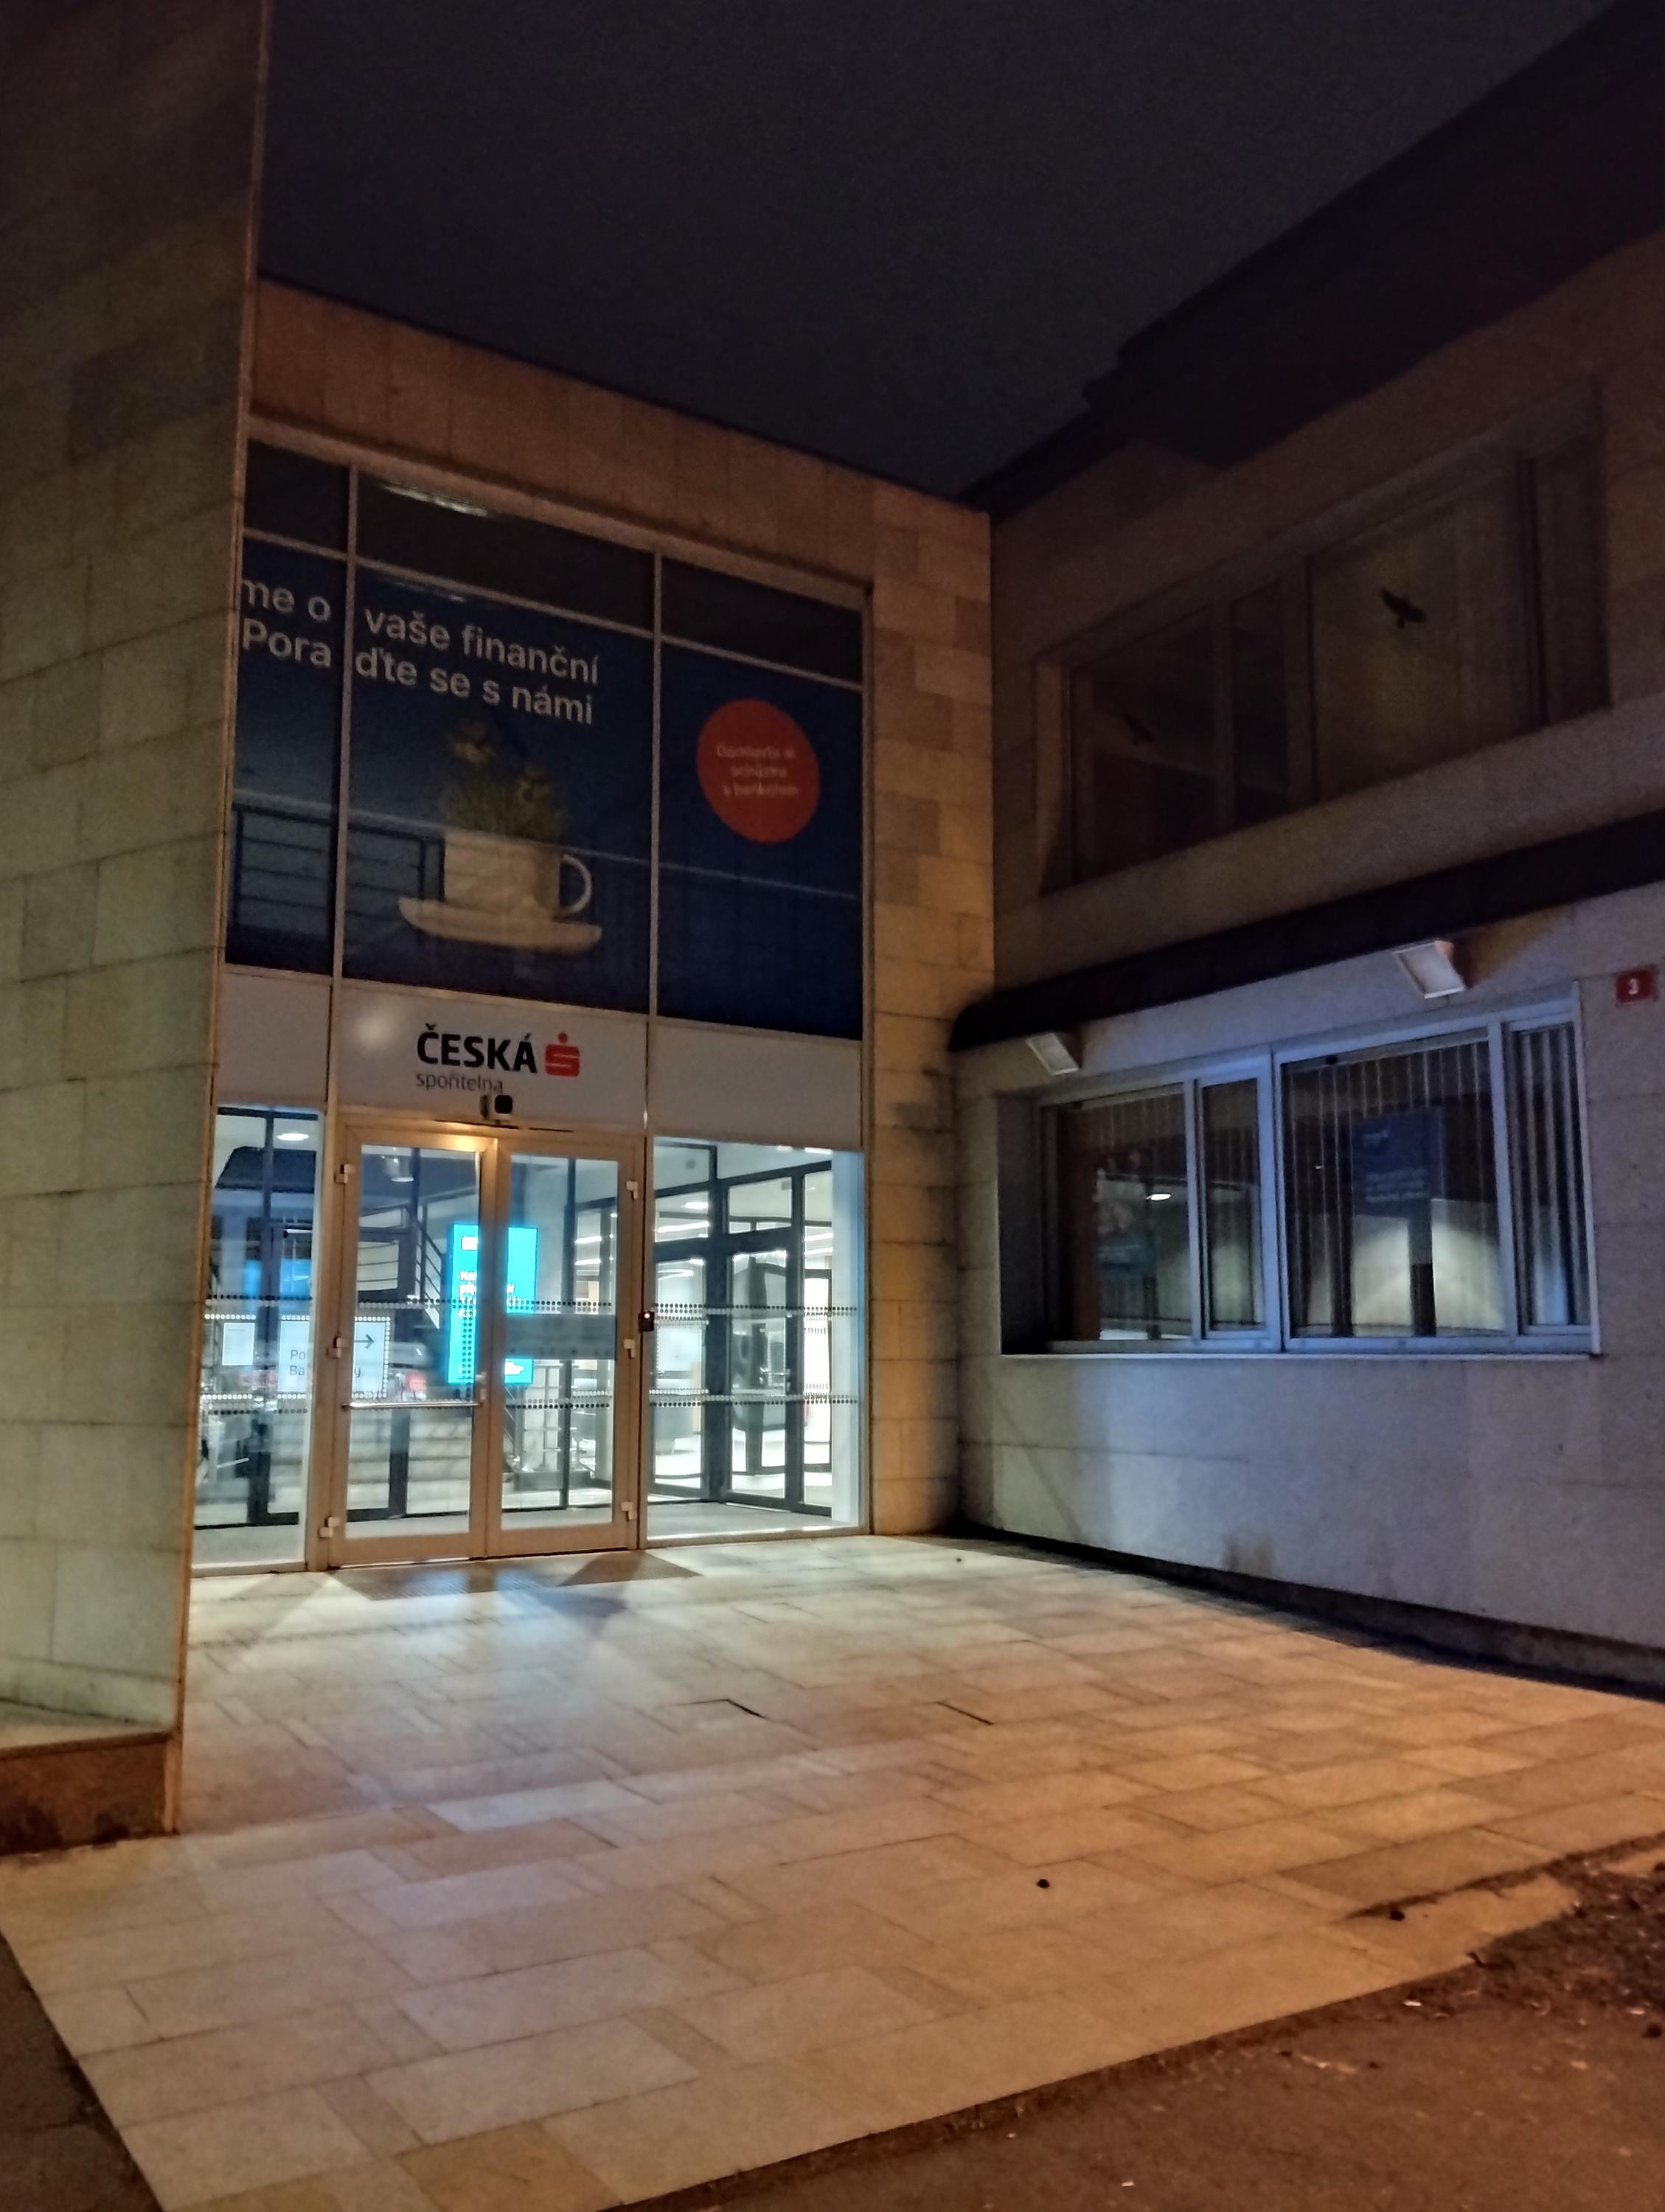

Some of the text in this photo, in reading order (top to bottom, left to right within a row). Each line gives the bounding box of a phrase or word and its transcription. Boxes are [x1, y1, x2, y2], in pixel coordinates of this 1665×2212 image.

[307, 596, 331, 622] o
[365, 608, 451, 651] vaše
[462, 625, 599, 686] finanční
[430, 667, 470, 698] se
[482, 679, 500, 706] s
[512, 684, 592, 725] námi
[417, 1022, 538, 1074] ČESKÁ
